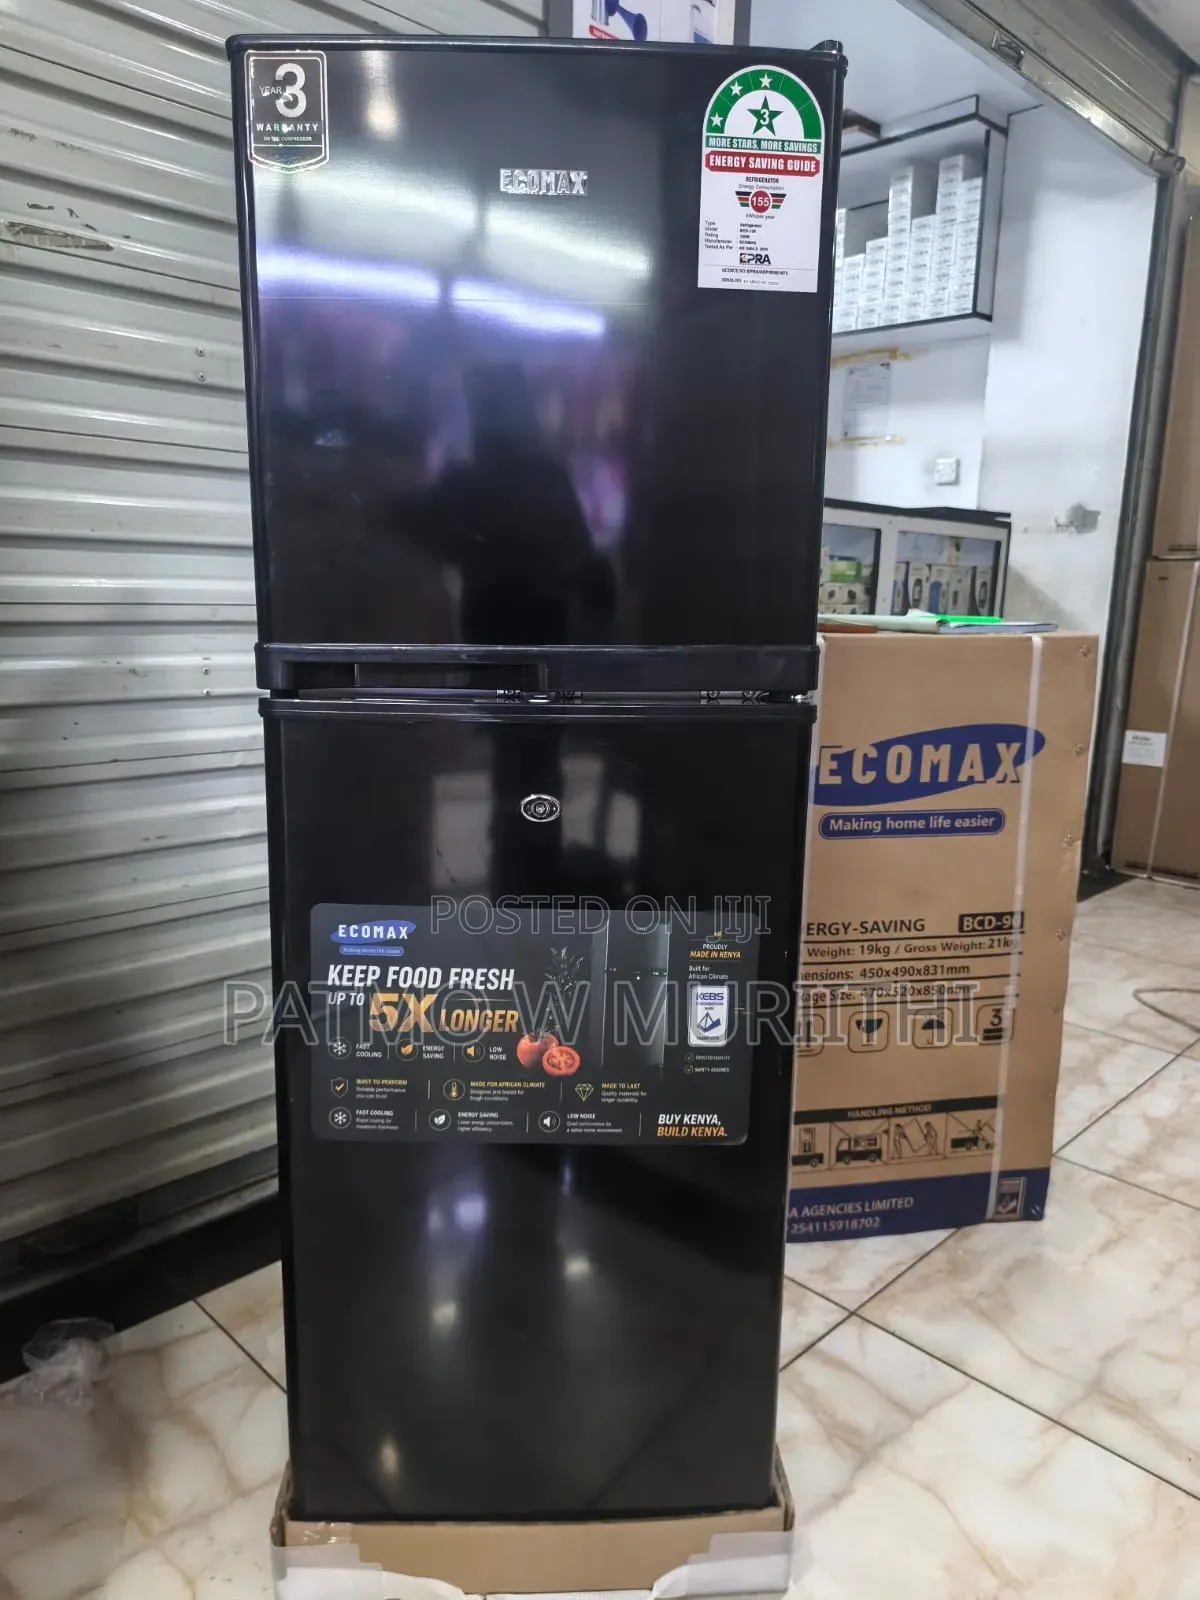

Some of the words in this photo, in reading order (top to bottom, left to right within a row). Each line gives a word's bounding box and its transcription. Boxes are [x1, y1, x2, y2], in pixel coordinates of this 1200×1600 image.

[259, 86, 282, 95] YEAR
[275, 63, 307, 118] 3
[760, 109, 769, 125] 3
[709, 137, 730, 148] MORE
[760, 140, 783, 151] MORE
[784, 142, 817, 153] SAVINGS
[709, 155, 746, 169] ENERGY
[748, 157, 785, 171] SAVING
[787, 159, 816, 172] GUIDE
[500, 168, 587, 195] ECOMAX
[751, 197, 770, 207] 155
[740, 253, 771, 265] EPRA
[818, 743, 1023, 785] ECOMAX
[829, 816, 881, 833] Making
[886, 817, 925, 830] home
[930, 815, 952, 828] life
[954, 815, 995, 828] easier
[338, 924, 408, 940] ECOMAX
[719, 951, 741, 959] KENYA
[807, 947, 854, 959] Weight:
[860, 944, 890, 957] 19kg
[904, 943, 937, 954] Gross
[940, 940, 985, 953] Weight:
[328, 964, 381, 987] KEEP
[386, 965, 442, 989] FOOD
[448, 967, 515, 990] FRESH
[801, 968, 854, 981] ensions:
[860, 965, 970, 979] 450x490x831mm
[696, 992, 724, 1001] KEBS
[801, 989, 827, 1004] age
[328, 992, 346, 1006] UP
[350, 992, 365, 1006] TO
[368, 992, 438, 1033] 5X
[439, 1008, 519, 1033] LONGER
[422, 1052, 444, 1060] SAVING
[489, 1053, 507, 1061] NOISE
[848, 1107, 893, 1118] HANDLING
[895, 1103, 932, 1115] METHOD
[658, 1113, 681, 1125] BUY
[683, 1113, 721, 1126] KENYA,
[657, 1126, 689, 1137] BUILD
[691, 1126, 728, 1137] KENYA.
[801, 1201, 862, 1217] AGENCIES
[864, 1196, 915, 1212] LIMITED
